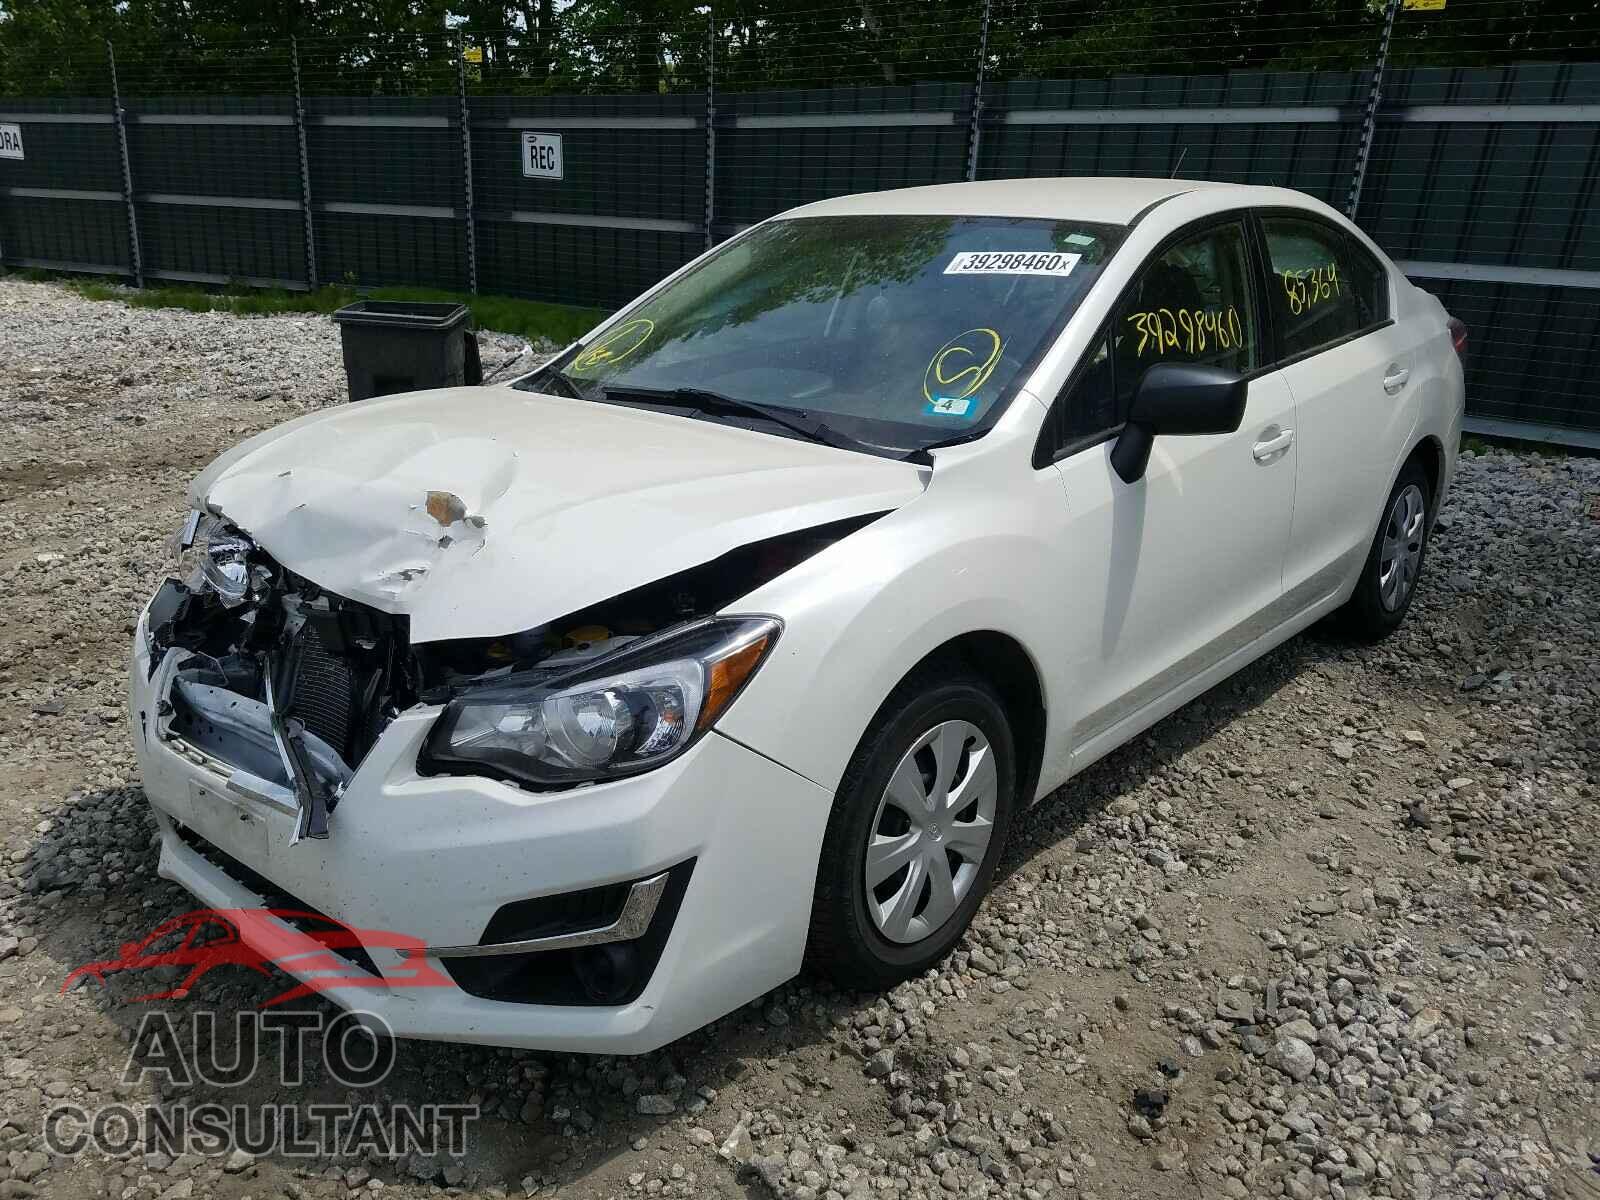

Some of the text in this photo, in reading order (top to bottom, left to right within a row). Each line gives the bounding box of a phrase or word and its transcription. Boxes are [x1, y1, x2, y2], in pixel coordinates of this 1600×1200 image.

[530, 145, 555, 170] REC
[1127, 305, 1243, 357] 39298460
[941, 399, 954, 411] 4
